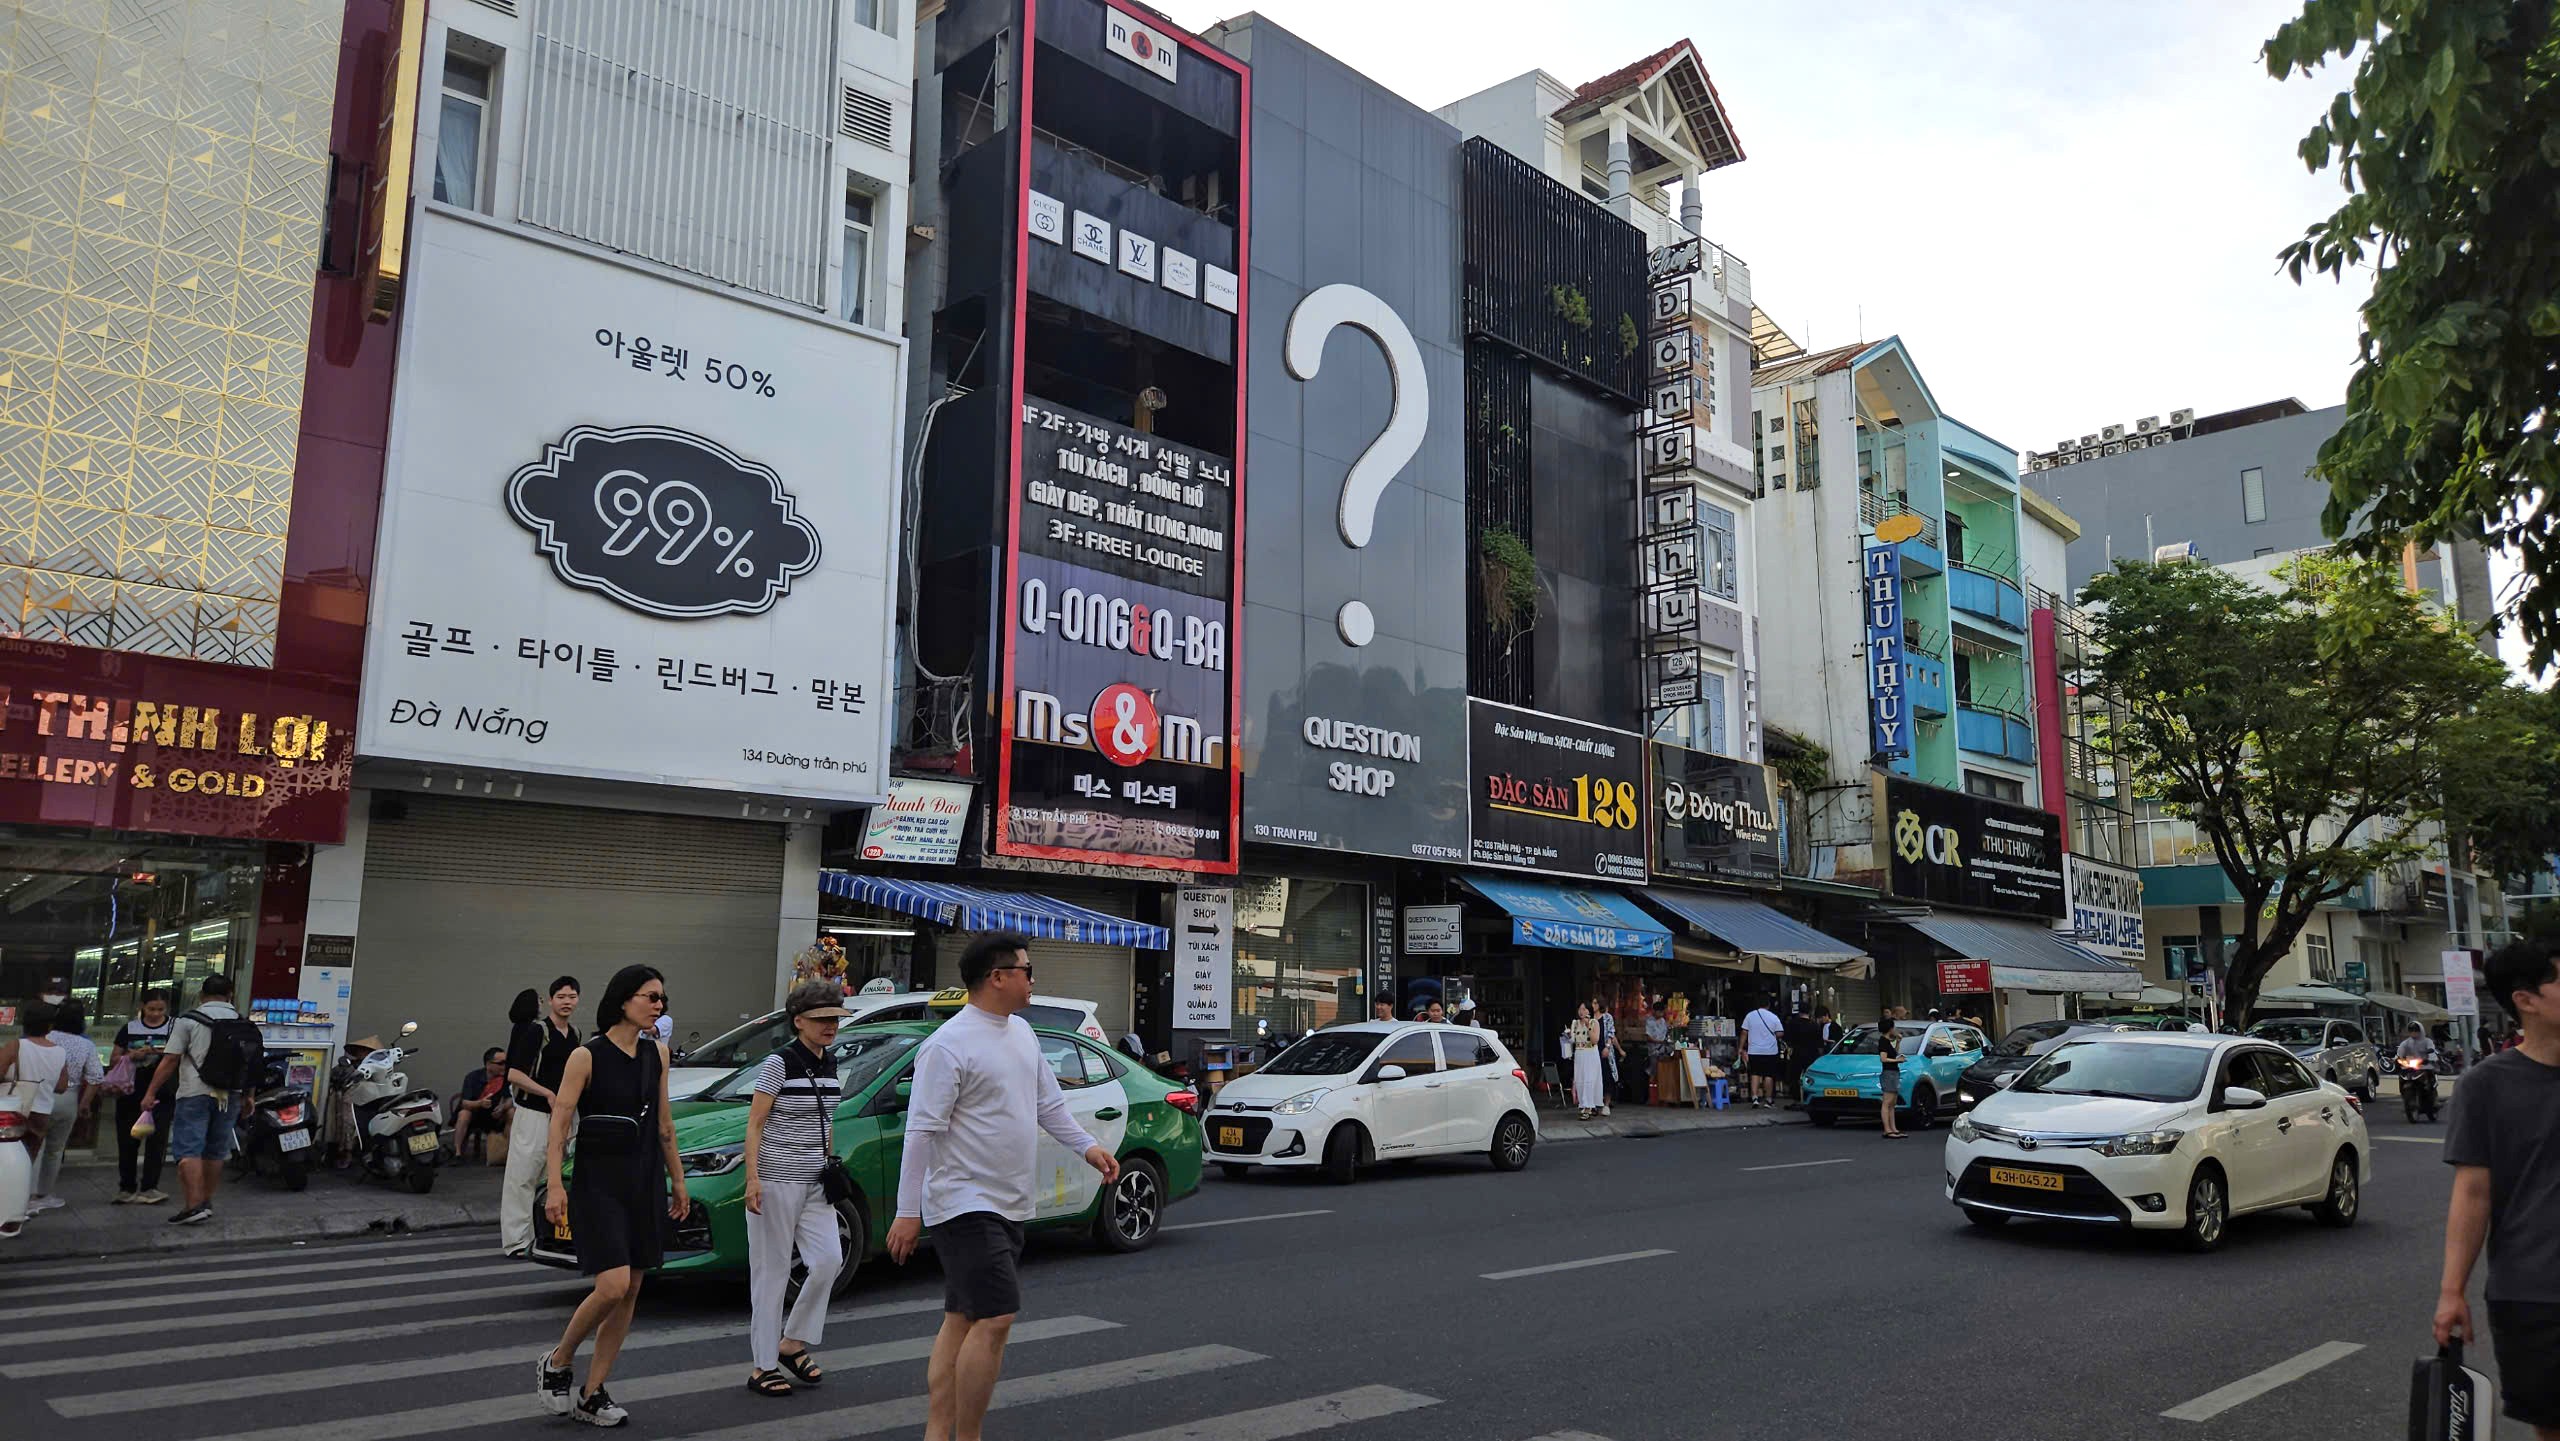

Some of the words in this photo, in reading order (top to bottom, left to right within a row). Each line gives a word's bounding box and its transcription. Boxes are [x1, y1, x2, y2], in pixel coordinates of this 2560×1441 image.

[1033, 199, 1057, 214] GUCCI
[1077, 237, 1108, 255] CHANEL
[595, 327, 689, 381] 아울렛
[704, 359, 776, 398] 50%
[1075, 421, 1111, 454] 가방
[1115, 434, 1150, 460] 시계
[1156, 447, 1191, 480] 신발
[1197, 459, 1231, 487] 노니
[1057, 448, 1085, 474] TÚI
[1140, 470, 1181, 502] ĐỒNG
[1182, 483, 1205, 508] HỒ
[594, 469, 754, 579] 99%
[1085, 530, 1132, 558] FREE
[1871, 551, 1895, 629] THU
[401, 620, 475, 658] 골프
[517, 637, 620, 683] 타이틀
[656, 656, 779, 697] 린드버그
[810, 678, 866, 715] 말본
[389, 698, 442, 727] Đà
[1112, 692, 1148, 755] &
[1303, 716, 1421, 763] QUESTION
[1537, 733, 1554, 746] Nam
[742, 748, 764, 764] 134
[766, 749, 811, 770] Đường
[812, 753, 841, 772] trần
[842, 758, 868, 777] phú
[130, 763, 156, 789] &
[168, 768, 265, 798] GOLD
[1074, 773, 1112, 799] 미스
[1123, 780, 1177, 809] 미스터
[1329, 761, 1396, 797] SHOP
[1488, 772, 1528, 806] ĐẶC
[1532, 777, 1569, 811] SẢN
[1572, 773, 1638, 830] 128
[1689, 791, 1735, 831] Đông
[1022, 809, 1039, 821] 132
[1166, 825, 1187, 837] 0935
[1189, 827, 1204, 839] 639
[1205, 829, 1220, 840] 801
[1254, 824, 1270, 836] 130
[1271, 826, 1297, 840] TRAN
[1298, 829, 1317, 842] PHU
[1735, 828, 1752, 840] Wine
[1751, 832, 1767, 843] store
[1984, 835, 2004, 854] THU
[1412, 844, 1432, 856] 0377
[1926, 824, 1963, 869] CR
[1183, 892, 1227, 904] QUESTION
[1193, 908, 1217, 919] SHOP
[1408, 916, 1436, 924] QUESTION
[1201, 941, 1220, 952] XÁCH
[1594, 927, 1616, 948] 128
[1197, 955, 1210, 963] BAG
[1193, 983, 1213, 991] SHOES
[1189, 1013, 1216, 1021] CLOTHES
